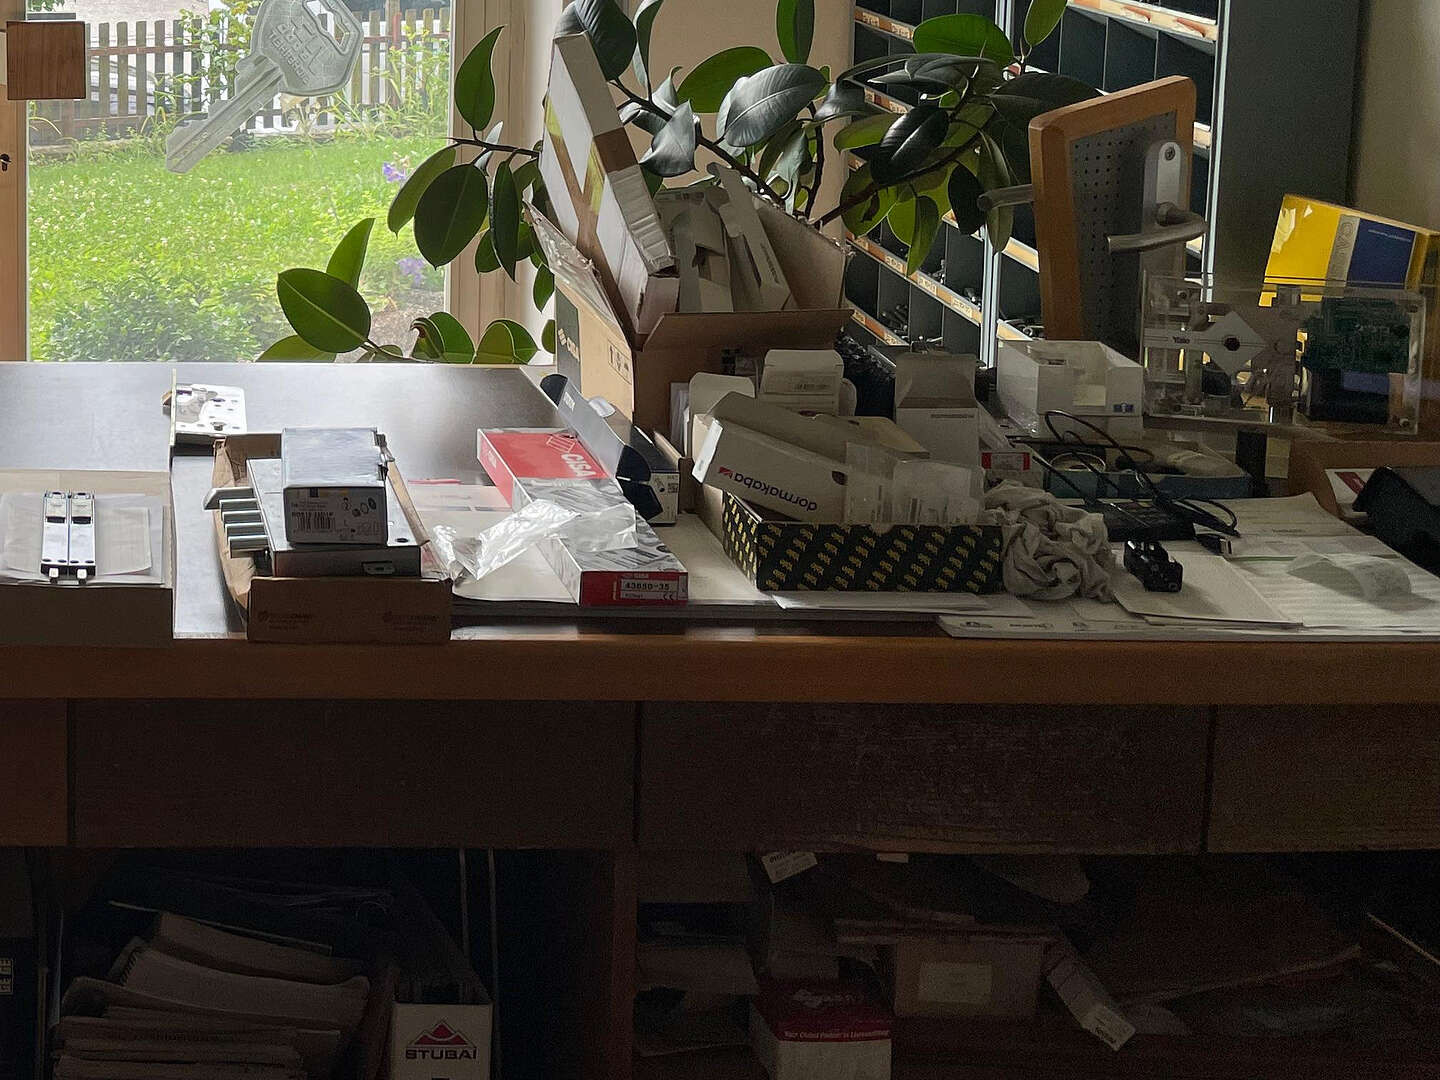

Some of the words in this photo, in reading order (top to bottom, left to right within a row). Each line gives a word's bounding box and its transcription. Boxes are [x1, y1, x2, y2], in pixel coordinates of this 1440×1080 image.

[561, 452, 597, 479] CISA
[733, 472, 818, 512] dormakaba
[404, 1048, 478, 1060] STUBAI
